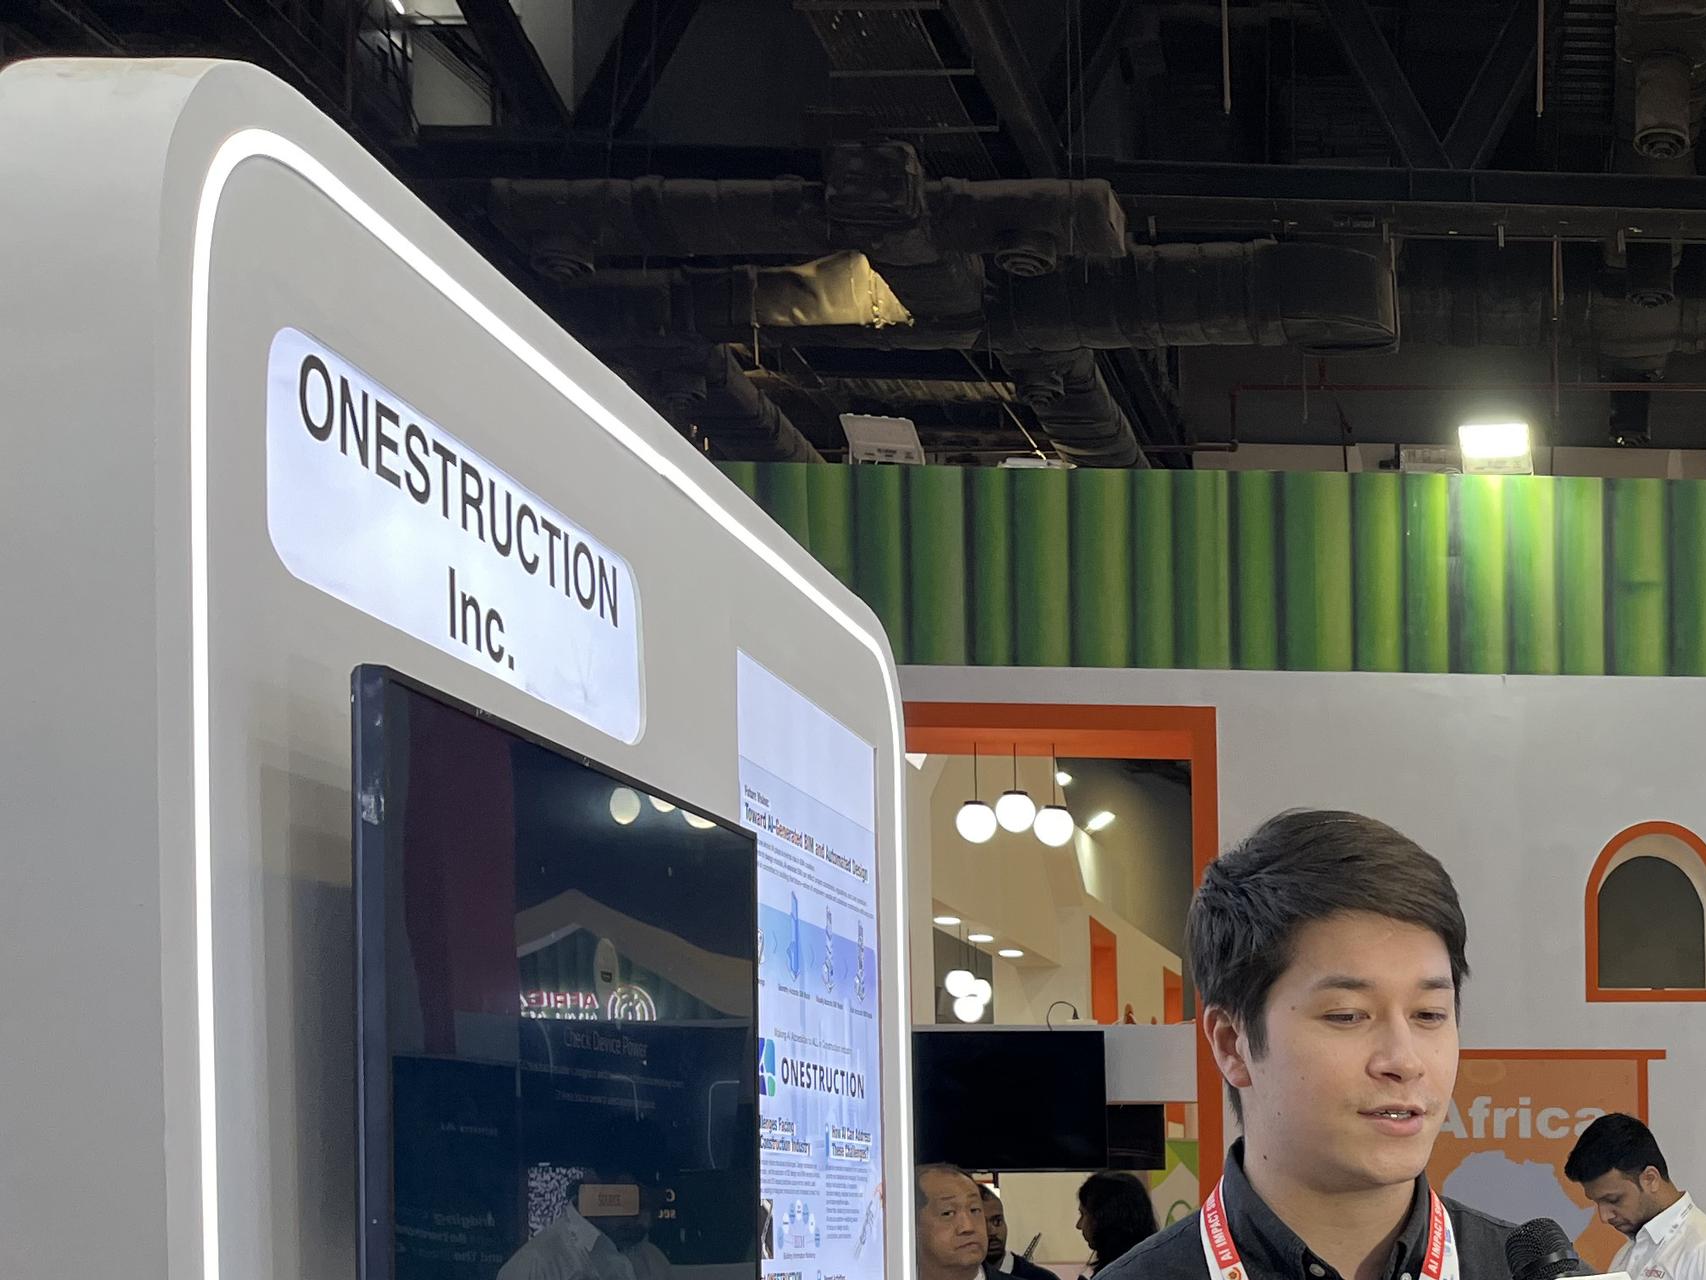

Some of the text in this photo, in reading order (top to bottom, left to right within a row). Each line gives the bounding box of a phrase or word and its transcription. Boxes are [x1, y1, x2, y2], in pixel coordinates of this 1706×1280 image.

[298, 353, 620, 628] ONESTRUCTION
[447, 566, 516, 671] Inc.
[744, 802, 767, 831] Toward
[563, 1027, 649, 1059] Check Device Power
[781, 1057, 865, 1099] ONESTRUCTION
[760, 1114, 795, 1136] llenges Facing
[1207, 1210, 1228, 1248] IMPACT
[1431, 1215, 1443, 1262] IMPACT
[1218, 1248, 1233, 1261] AI
[1427, 1262, 1438, 1274] AI
